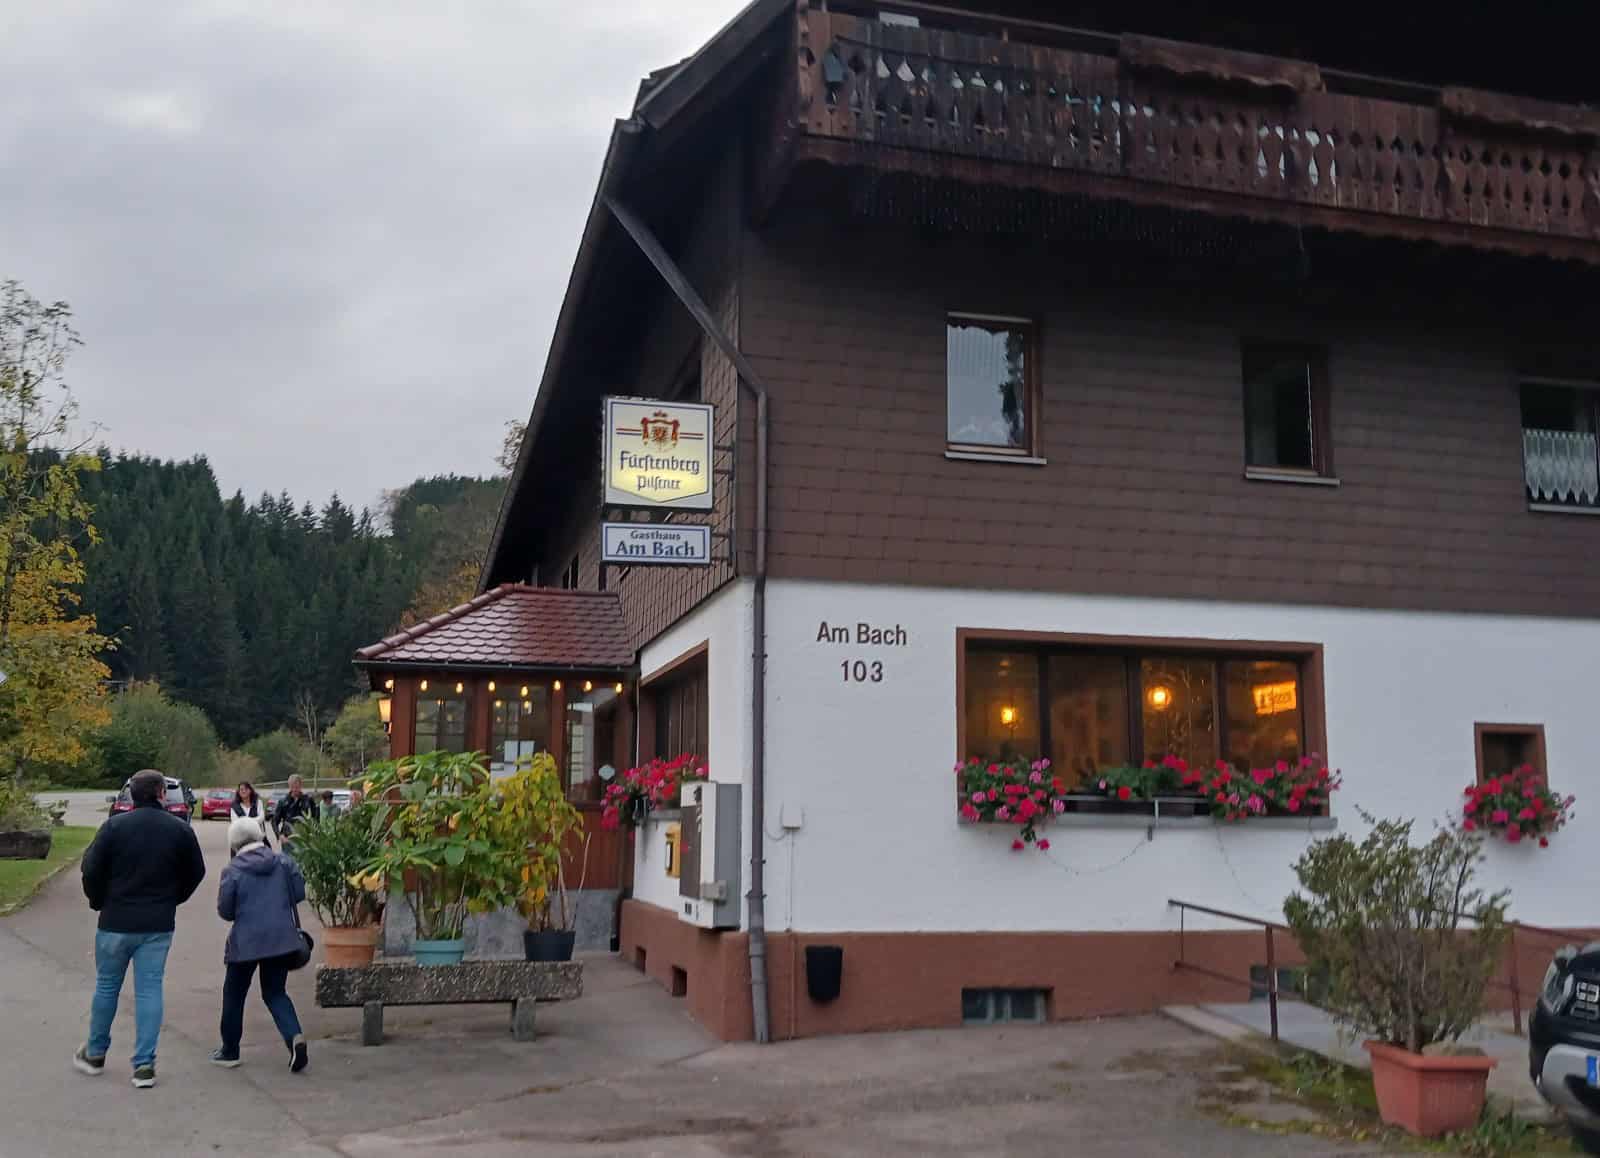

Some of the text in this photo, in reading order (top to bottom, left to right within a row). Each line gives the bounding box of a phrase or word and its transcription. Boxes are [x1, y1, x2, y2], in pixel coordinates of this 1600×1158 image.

[630, 530, 681, 541] Gasthaus
[615, 541, 695, 557] Am Bach
[816, 621, 907, 646] Am Bach
[841, 660, 883, 682] 103
